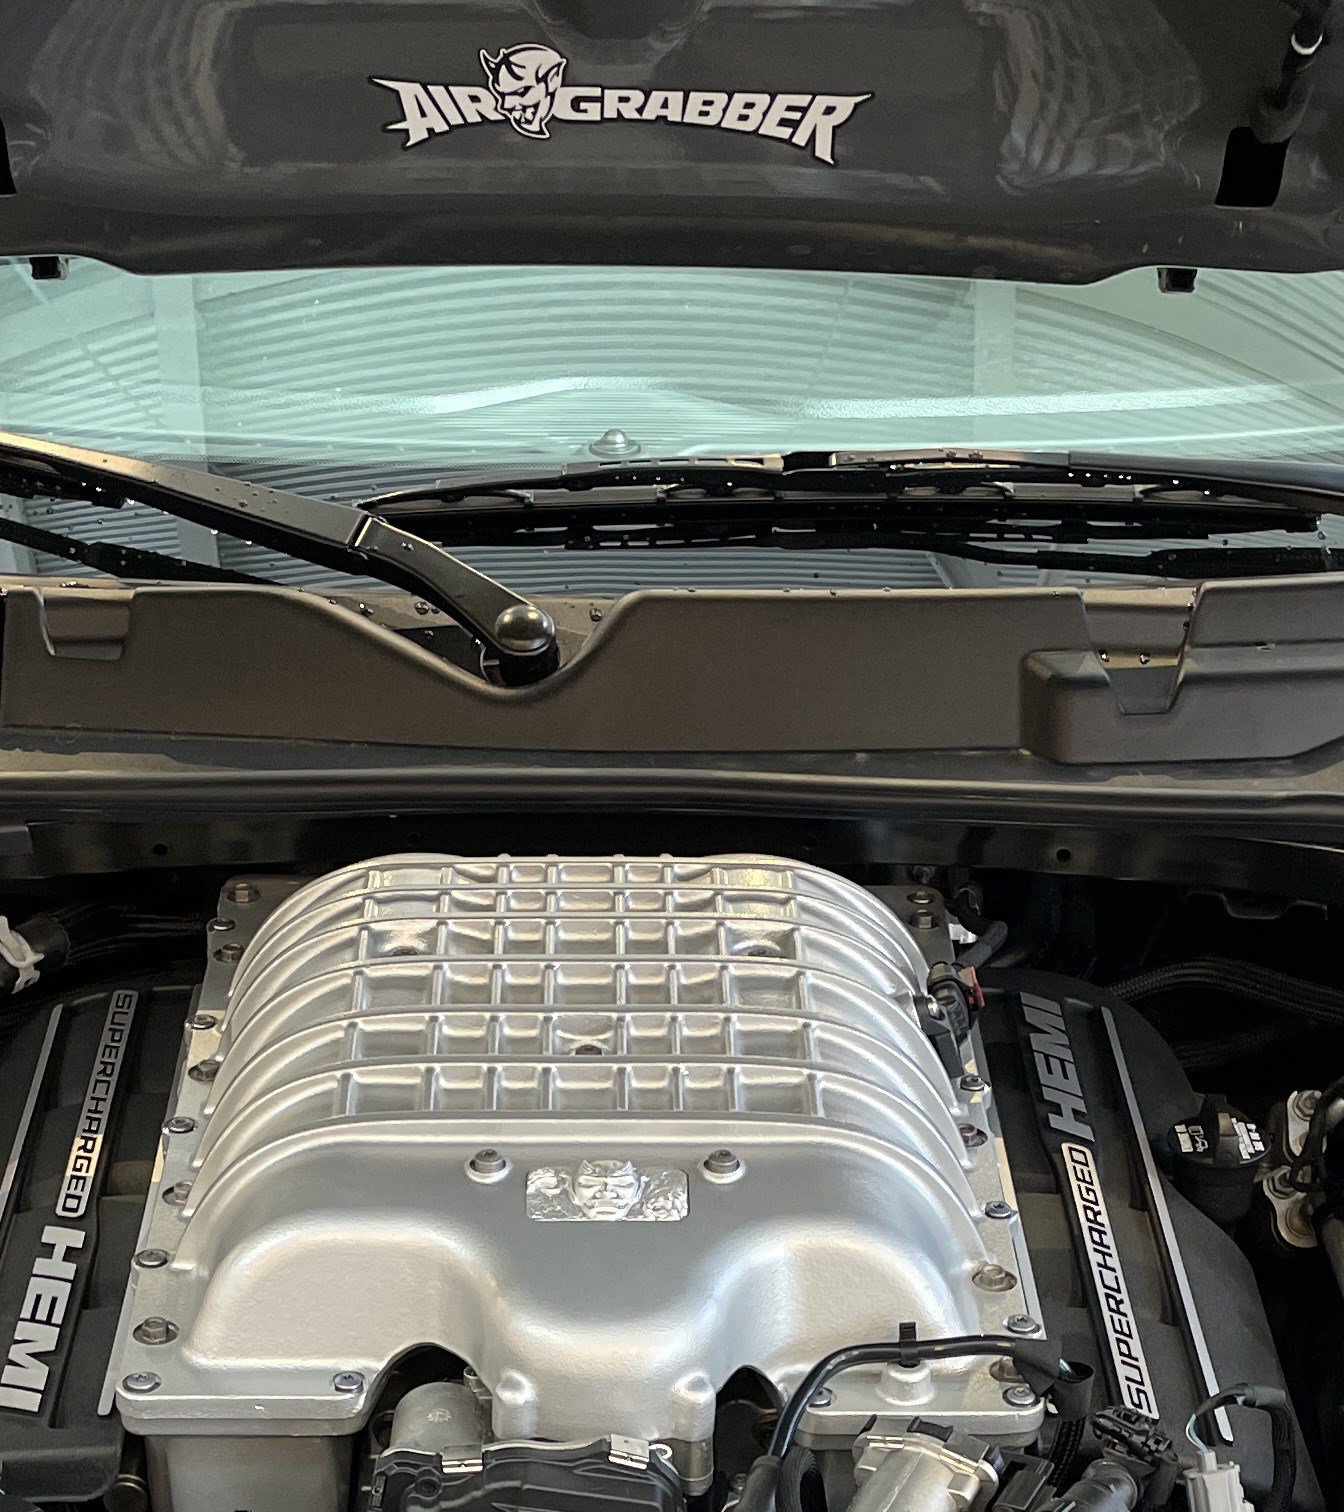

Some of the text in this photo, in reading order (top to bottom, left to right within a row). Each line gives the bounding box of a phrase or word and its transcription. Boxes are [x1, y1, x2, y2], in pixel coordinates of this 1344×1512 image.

[372, 78, 872, 164] AIR GRABBER
[59, 992, 137, 1215] SUPERCHARGED
[1021, 992, 1095, 1142] HEMI
[1064, 1144, 1157, 1417] SUPERCHARGED
